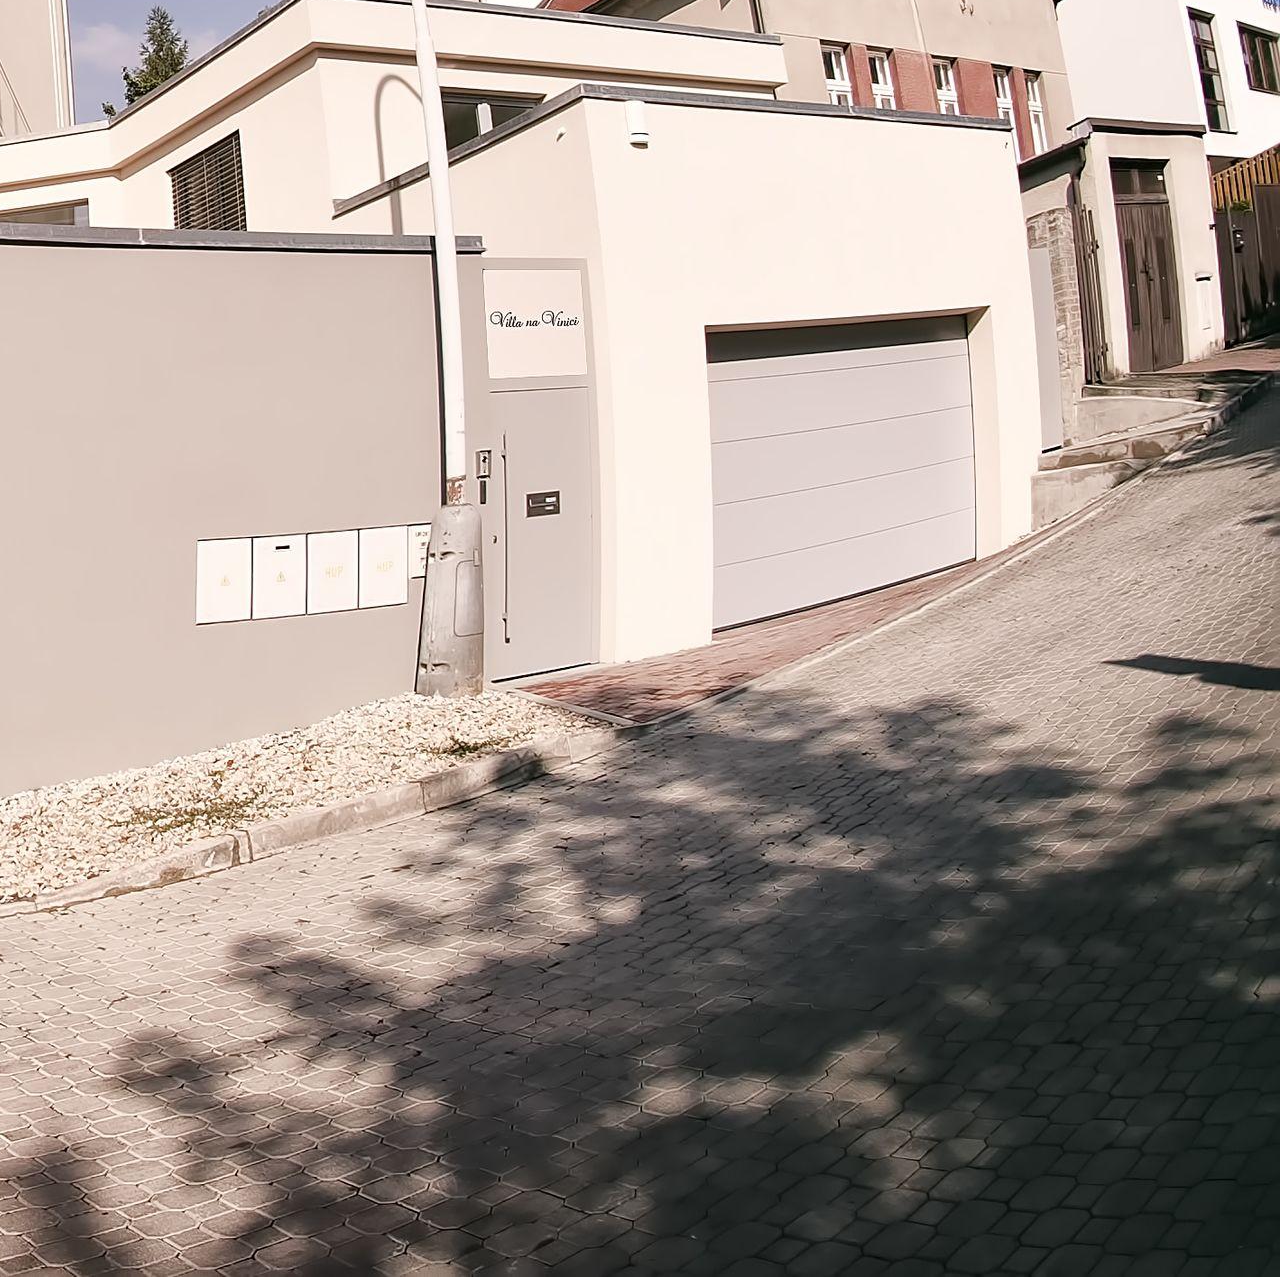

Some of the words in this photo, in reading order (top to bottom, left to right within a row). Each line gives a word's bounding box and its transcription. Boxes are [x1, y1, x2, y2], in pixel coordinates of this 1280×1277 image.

[489, 310, 523, 328] Villa
[525, 319, 540, 327] na
[541, 310, 579, 327] Vinici
